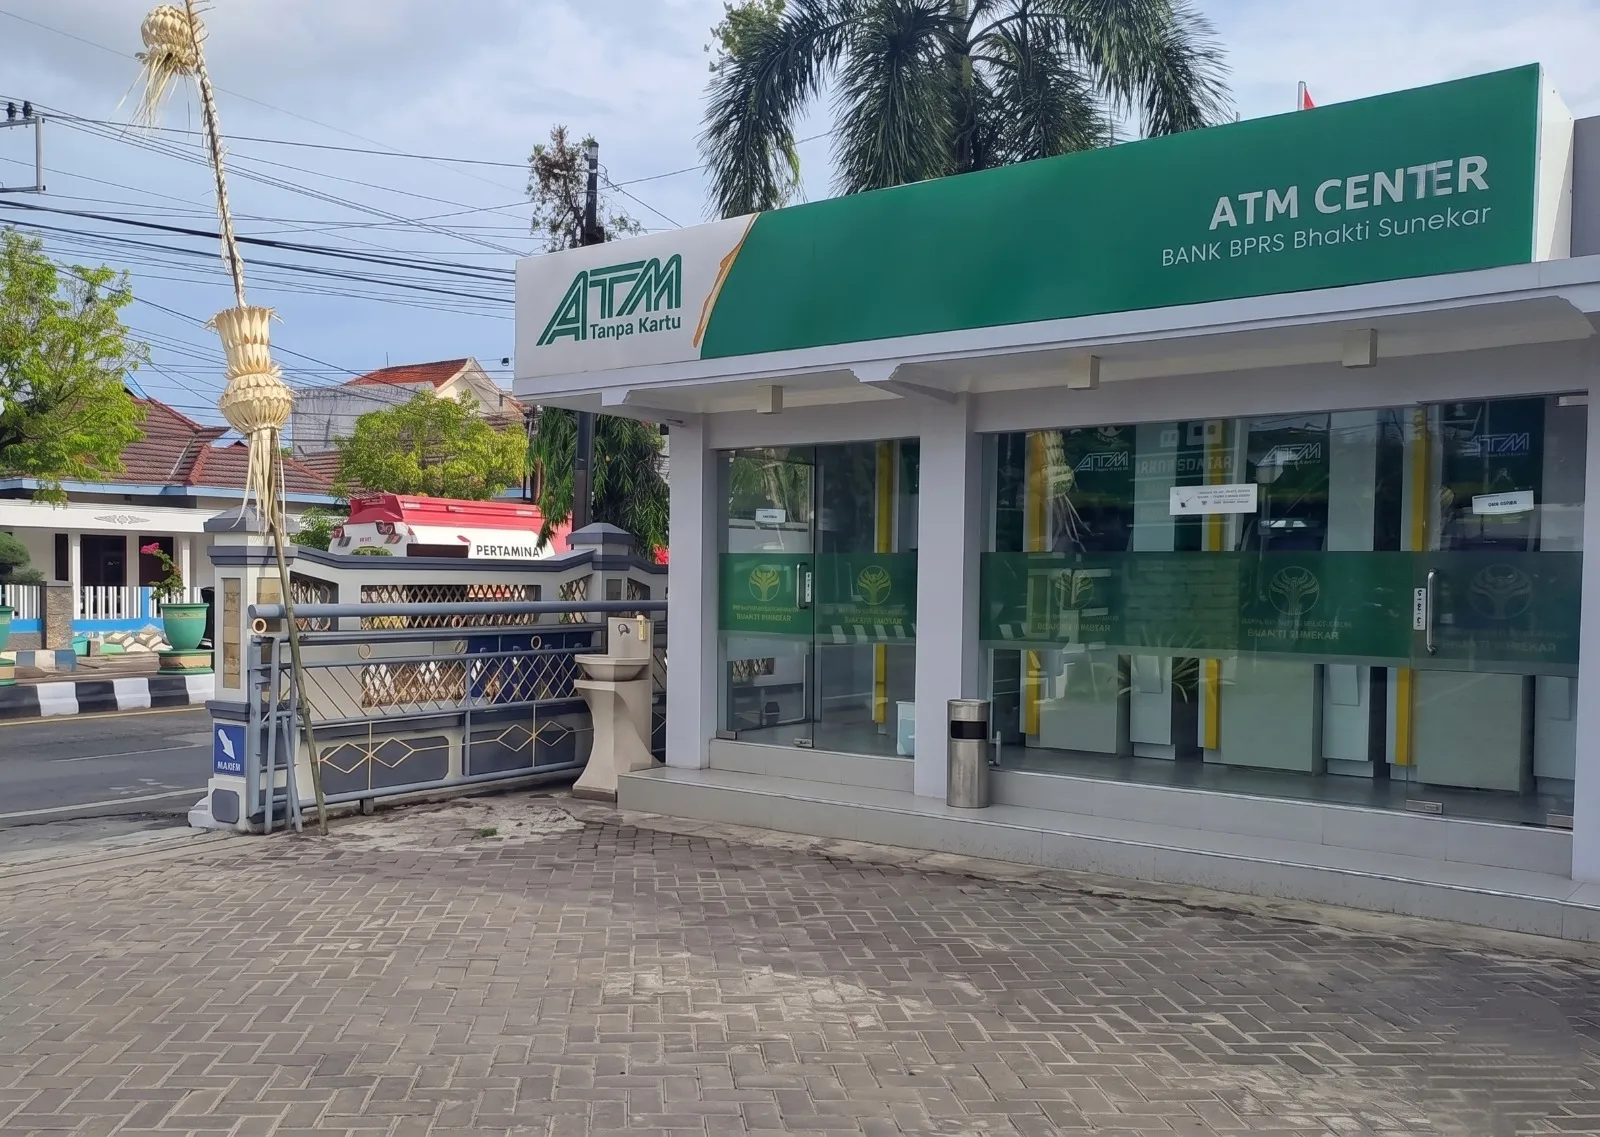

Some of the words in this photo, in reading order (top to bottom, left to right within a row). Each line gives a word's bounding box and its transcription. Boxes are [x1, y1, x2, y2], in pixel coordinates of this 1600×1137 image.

[1209, 186, 1298, 230] ATM
[1314, 156, 1489, 214] CENTER
[1162, 242, 1221, 267] BANK
[1230, 233, 1285, 257] BPRS
[1294, 221, 1370, 248] Bhakti
[1378, 206, 1492, 237] Sunekar
[536, 253, 682, 346] ATM
[590, 322, 634, 341] Tanpa
[639, 315, 681, 334] Kartu
[1073, 451, 1129, 473] ATM
[476, 545, 540, 558] PERTAMINA
